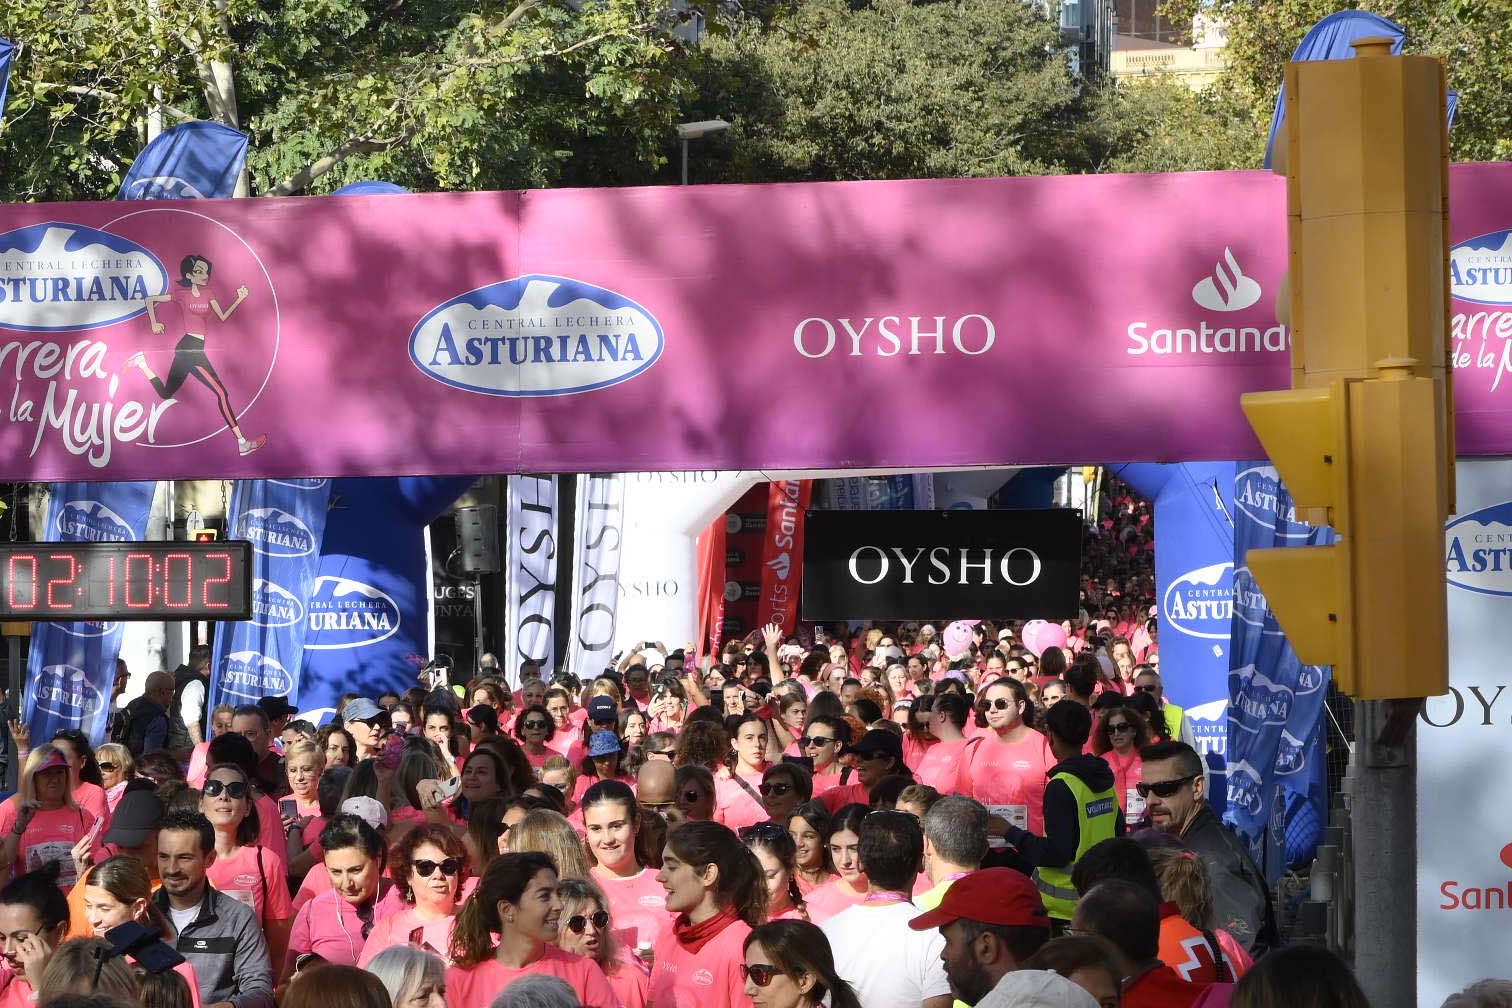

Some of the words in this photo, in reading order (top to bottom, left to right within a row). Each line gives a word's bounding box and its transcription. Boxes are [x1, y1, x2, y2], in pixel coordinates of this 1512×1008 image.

[72, 259, 144, 271] LECHERA
[1451, 258, 1512, 286] ASTU
[468, 317, 547, 330] CENTRAL
[554, 315, 637, 329] LECHERA
[793, 314, 996, 358] OYSHO
[1451, 311, 1512, 340] arre
[429, 322, 644, 366] ASTURIANA
[1127, 321, 1291, 356] Santand
[1476, 340, 1496, 368] la
[9, 382, 35, 422] la
[29, 376, 179, 468] Mujer
[579, 474, 621, 652] OYSH
[848, 545, 1042, 586] OYSHO
[1446, 535, 1512, 574] ASTU
[433, 585, 475, 600] UGES
[619, 579, 679, 598] YSHO
[1188, 589, 1233, 597] CENTRA
[338, 600, 388, 609] LECHERA
[770, 584, 787, 625] orts
[310, 611, 392, 631] URIANA
